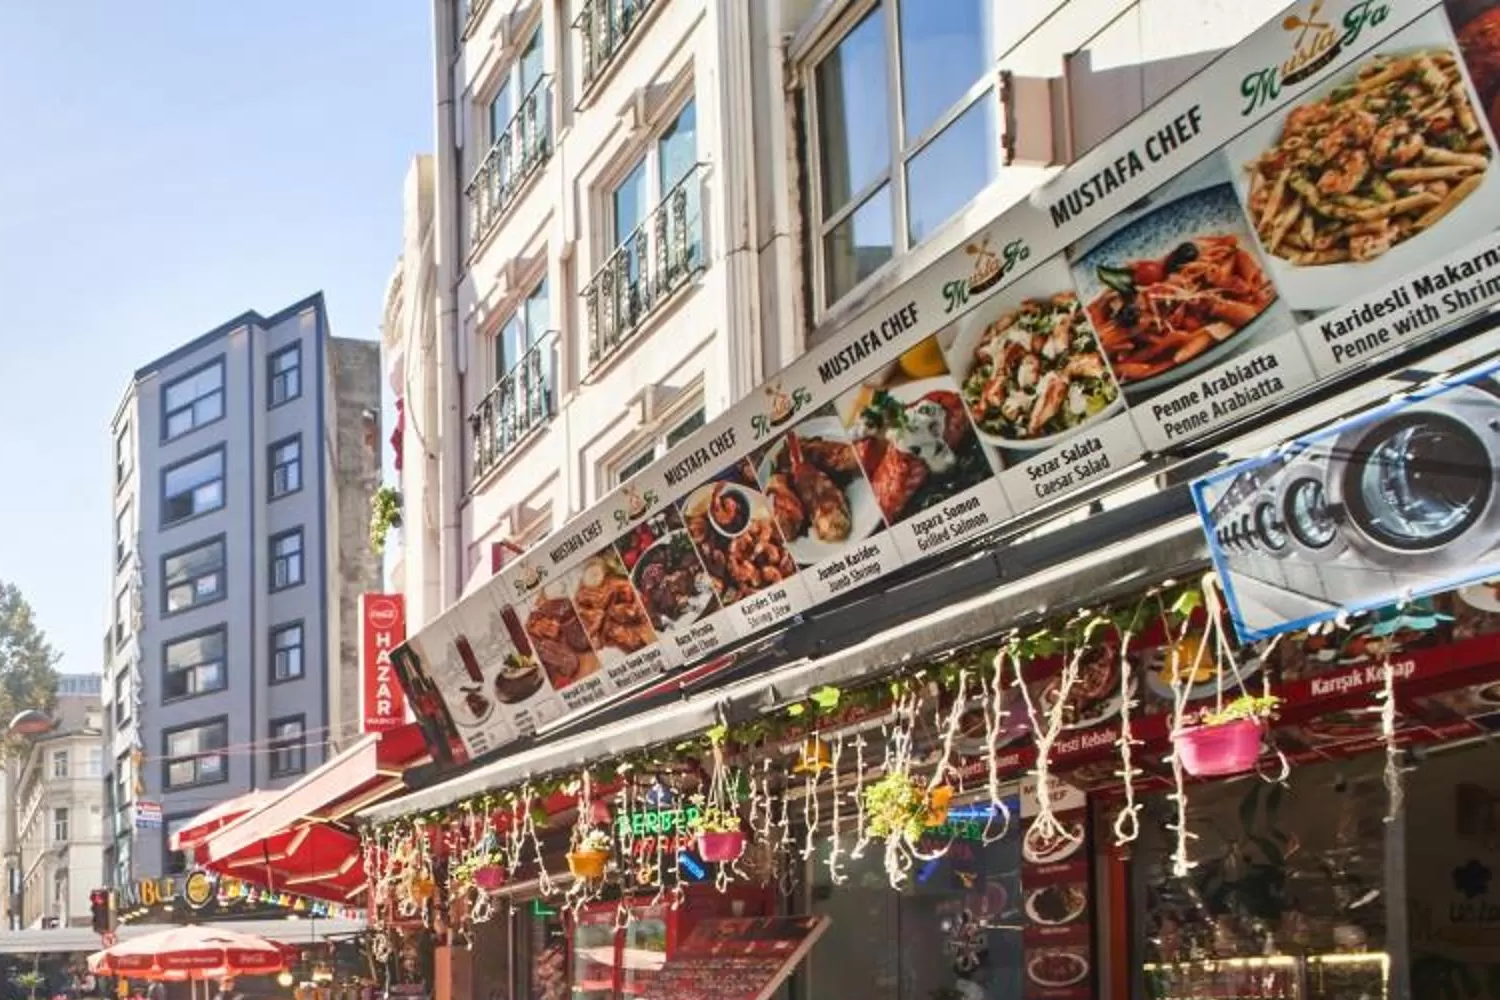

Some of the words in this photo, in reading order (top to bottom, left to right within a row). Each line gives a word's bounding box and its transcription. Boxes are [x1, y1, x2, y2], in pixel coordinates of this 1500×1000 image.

[1049, 149, 1145, 230] MUSTAFA
[1144, 104, 1202, 164] CHEF
[1320, 286, 1411, 343] Karidesli
[1412, 246, 1500, 300] Makarn
[817, 329, 882, 384] MUSTAFA
[880, 302, 919, 341] CHEF
[1331, 327, 1391, 364] Penne
[1393, 303, 1441, 336] with
[1152, 391, 1199, 422] Penne
[1202, 353, 1279, 399] Arabiatta
[1164, 411, 1209, 439] Penne
[1211, 377, 1285, 419] Arabiatta
[663, 447, 711, 487] MUSTAFA
[709, 427, 739, 458] CHEF
[1026, 457, 1062, 481] Sezar
[1060, 436, 1103, 465] Salata
[1035, 474, 1074, 499] Caesar
[1075, 453, 1111, 481] Salad
[911, 512, 944, 538] Izgara
[950, 511, 989, 536] Salmon
[375, 632, 392, 716] HAZAR
[1311, 670, 1363, 696] Karışık
[1366, 659, 1415, 684] Keap
